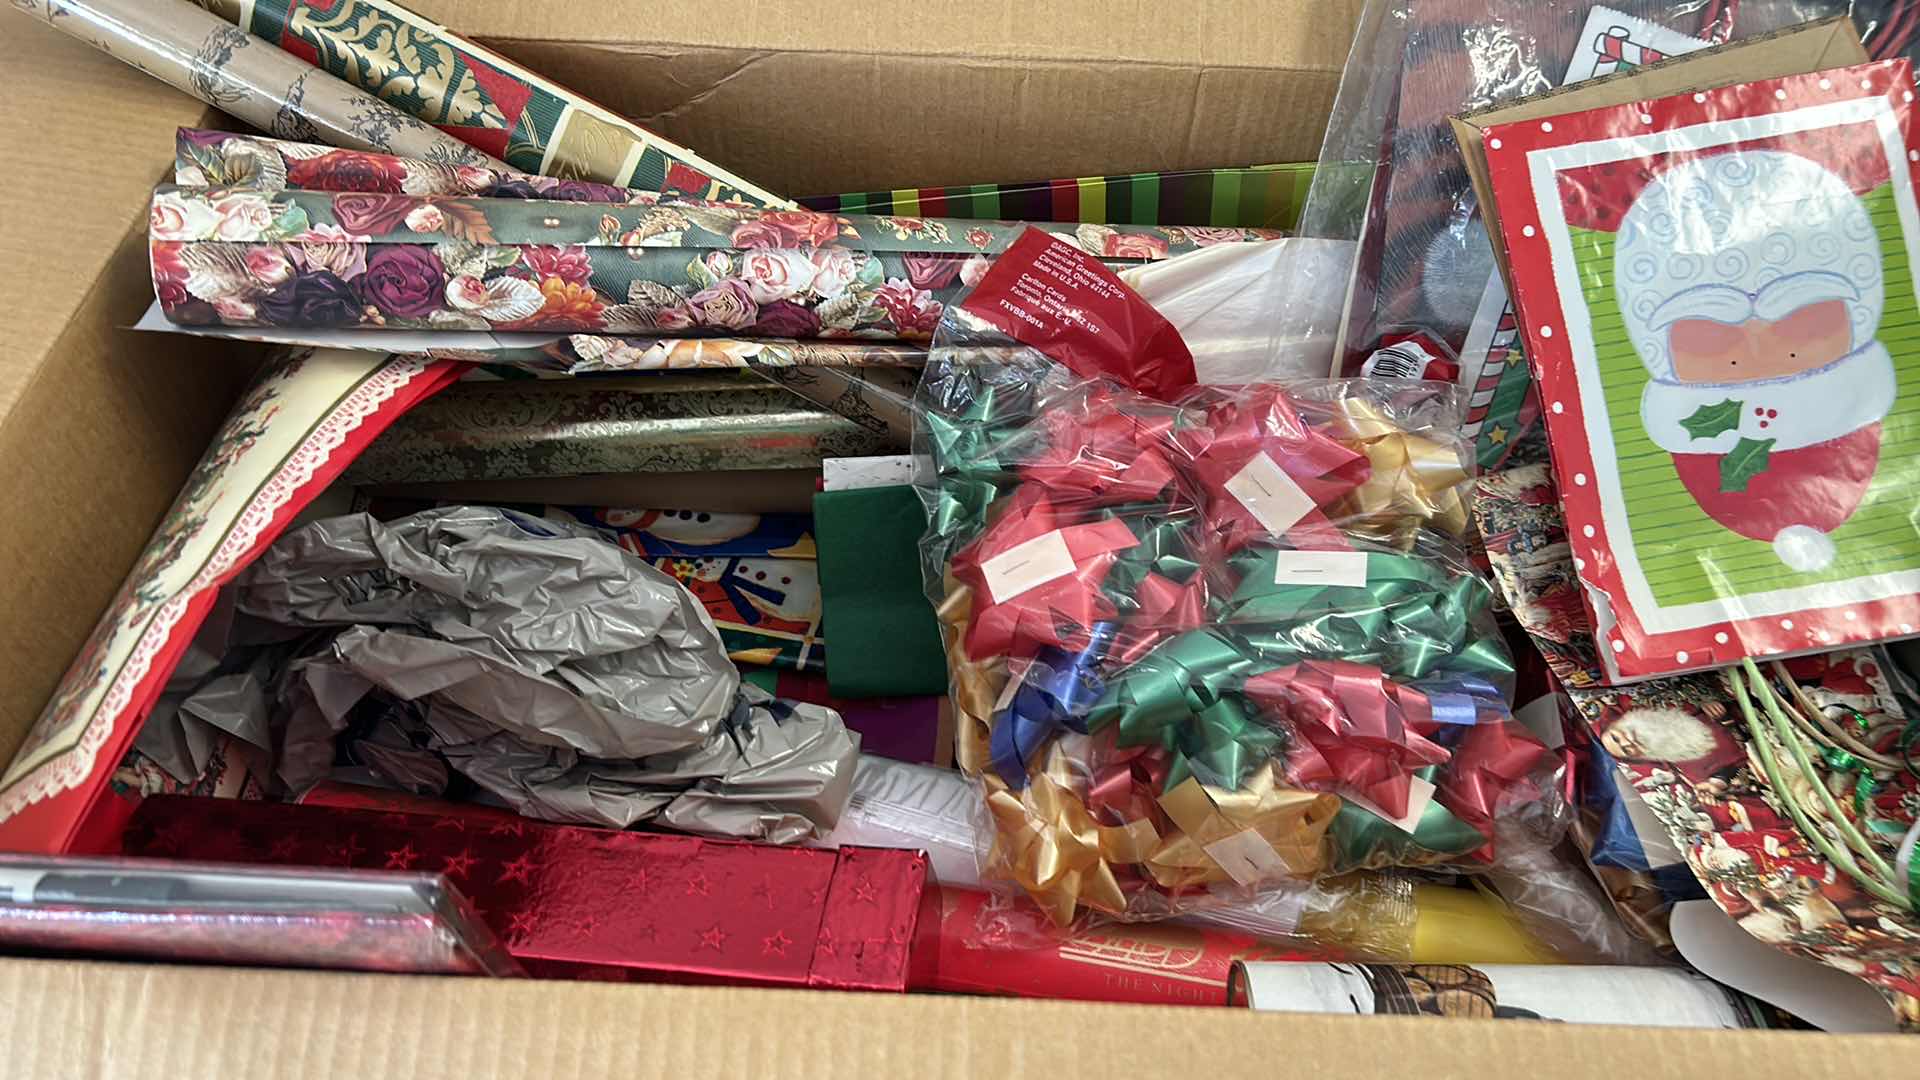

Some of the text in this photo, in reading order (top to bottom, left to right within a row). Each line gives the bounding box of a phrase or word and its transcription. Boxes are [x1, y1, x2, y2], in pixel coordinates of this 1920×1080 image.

[1032, 260, 1052, 273] Made
[1051, 269, 1060, 278] in
[1038, 254, 1111, 299] Cleveland, Ohio 44144
[1044, 248, 1127, 300] American Greetings Corp.
[1016, 279, 1042, 298] Toronto,
[1021, 272, 1067, 302] Carlton Cards
[1040, 304, 1055, 315] aux
[1104, 973, 1145, 991] THE
